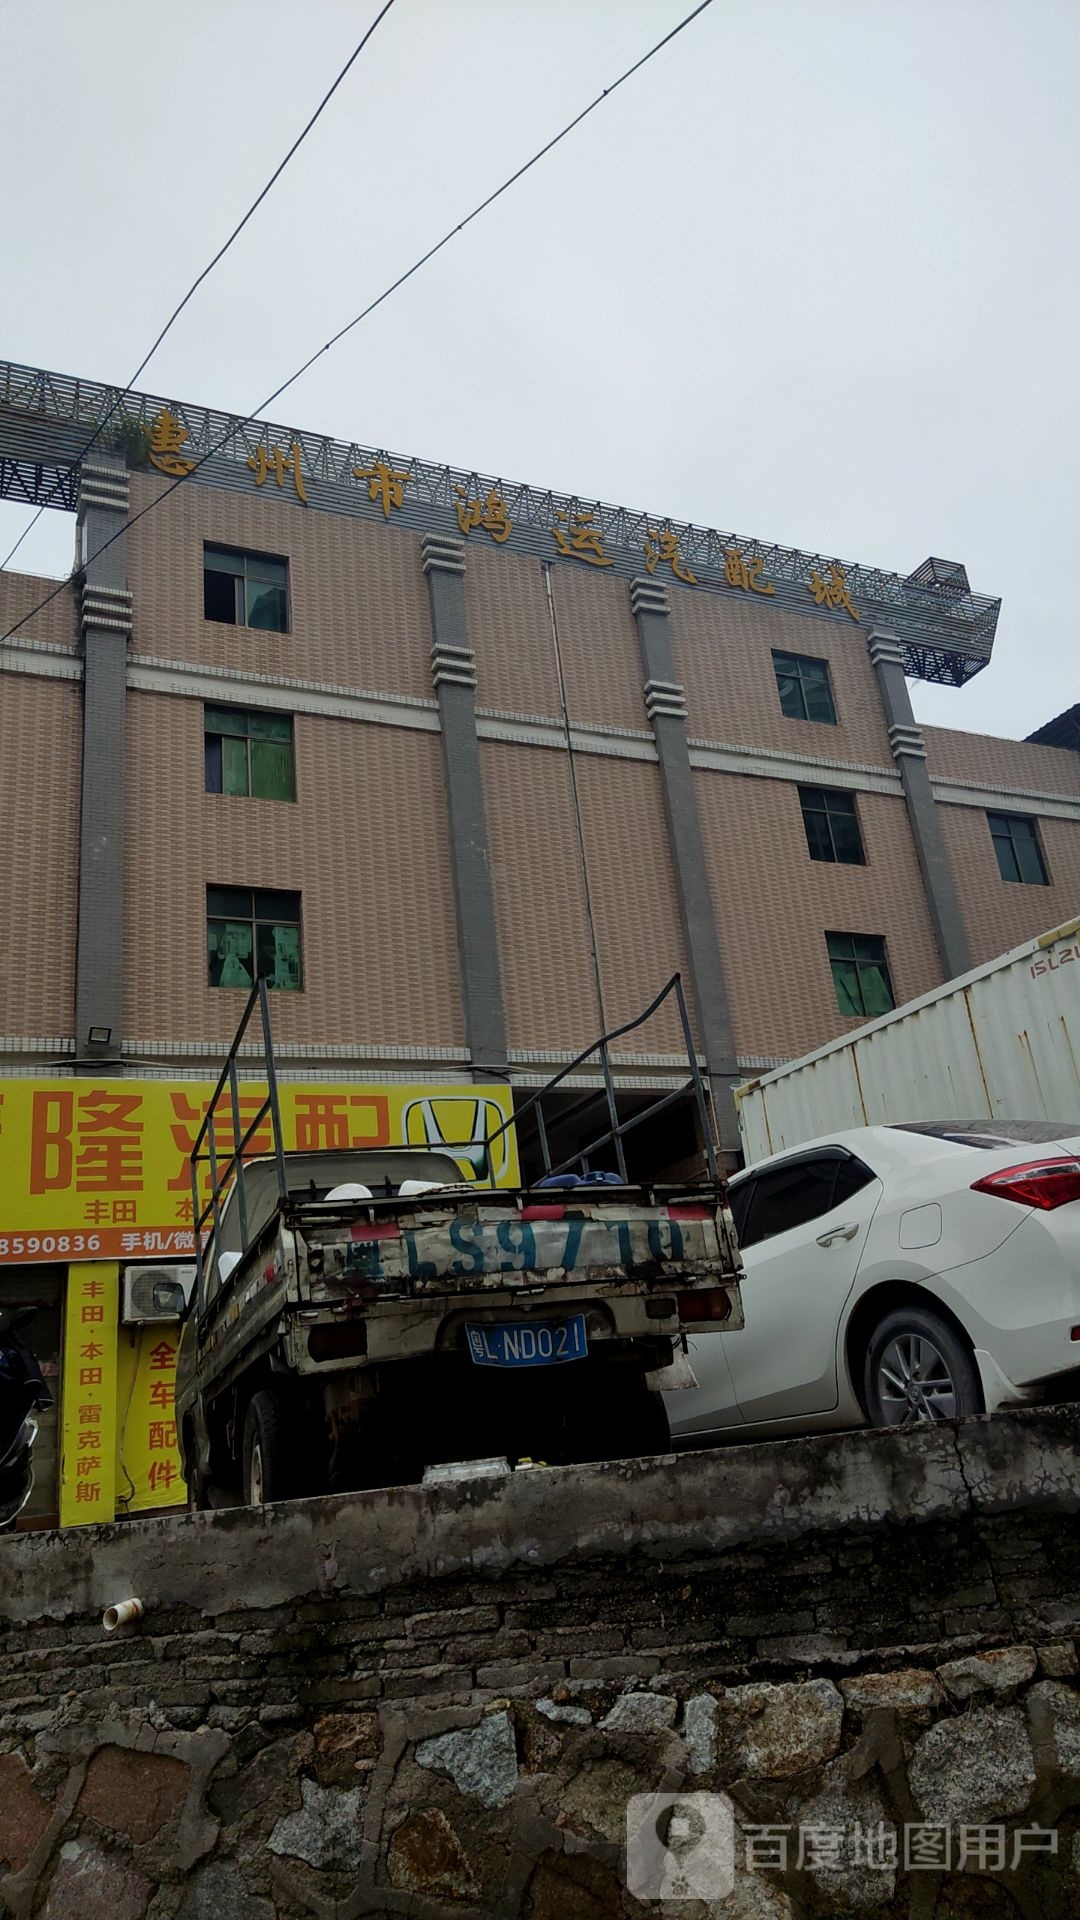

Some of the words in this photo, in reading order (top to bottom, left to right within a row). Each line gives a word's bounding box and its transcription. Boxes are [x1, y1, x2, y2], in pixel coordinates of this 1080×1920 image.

[145, 408, 860, 621] 惠州市鸿运汽配城
[0, 1089, 390, 1195] 隆汽配
[0, 1234, 101, 1255] 8590836
[84, 1199, 137, 1224] 丰田
[345, 1219, 686, 1279] LS9710
[148, 1341, 177, 1492] 全车配件
